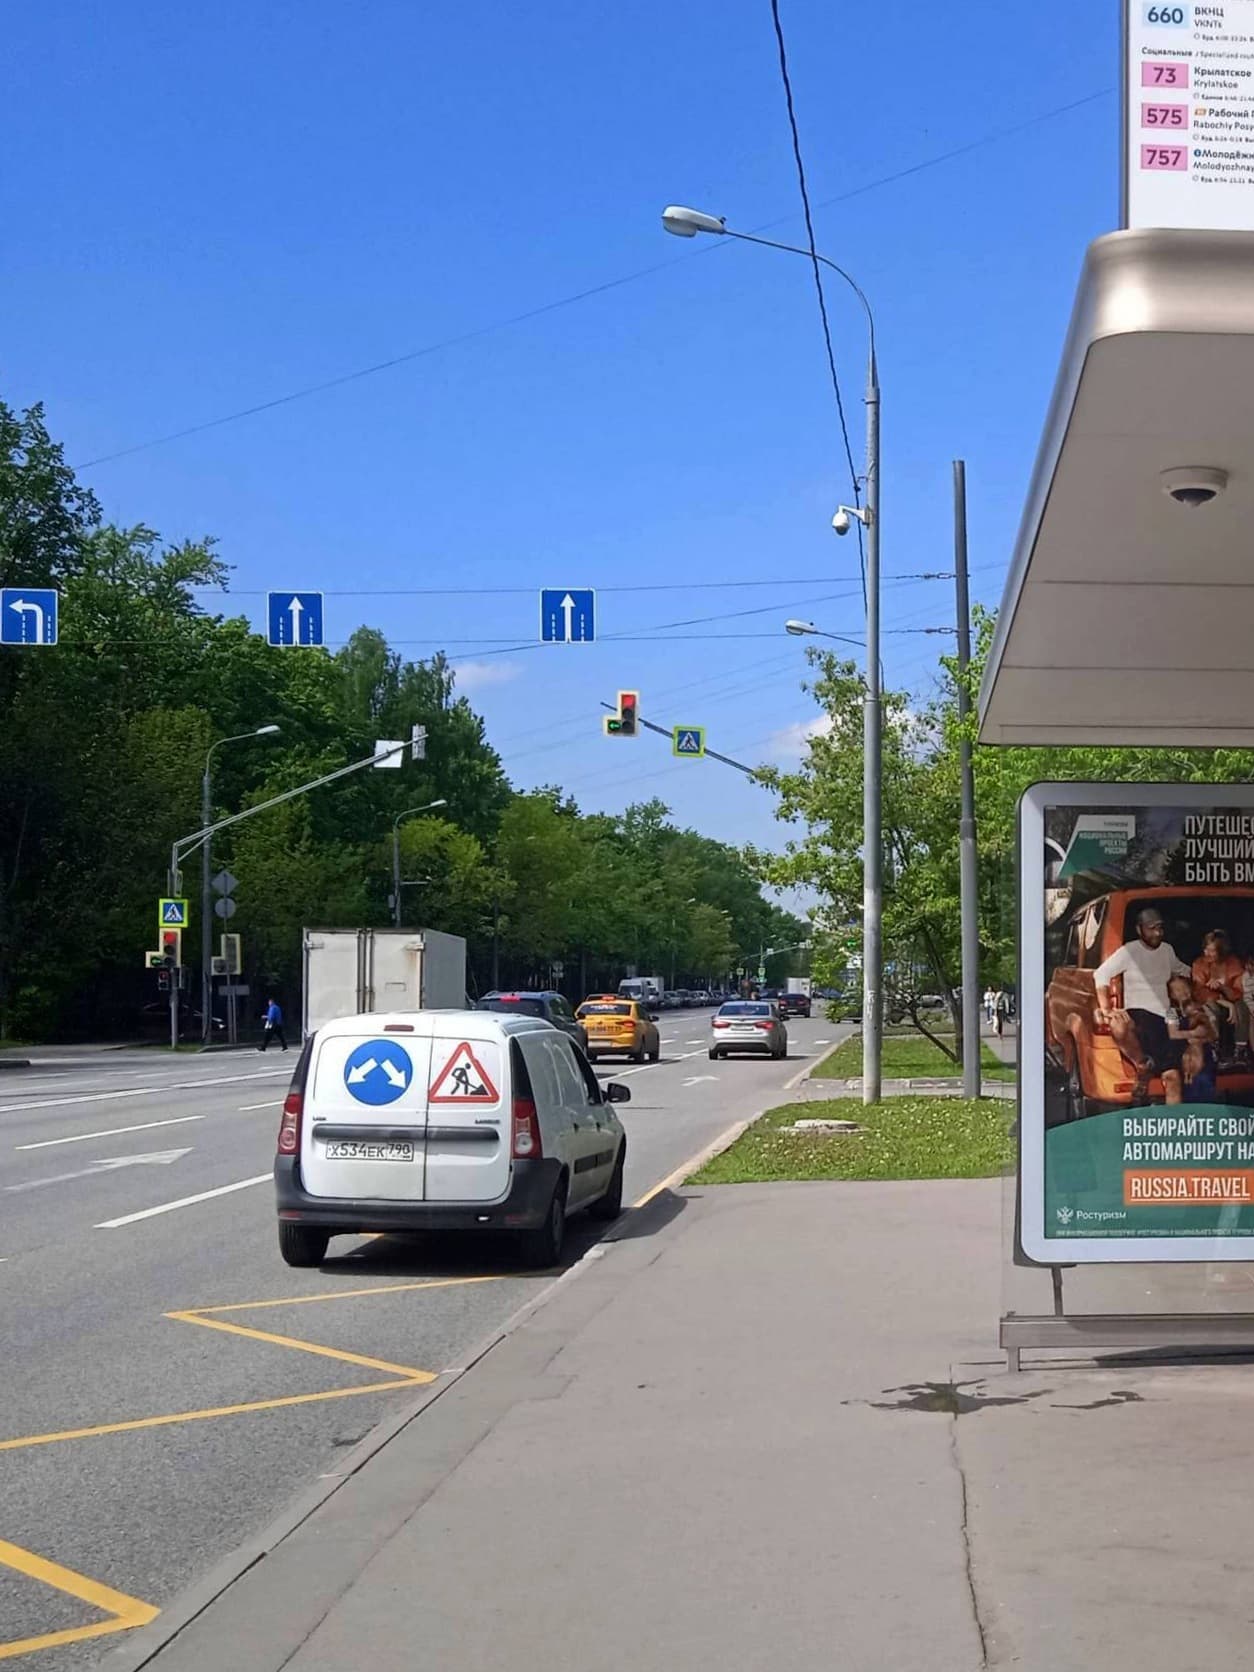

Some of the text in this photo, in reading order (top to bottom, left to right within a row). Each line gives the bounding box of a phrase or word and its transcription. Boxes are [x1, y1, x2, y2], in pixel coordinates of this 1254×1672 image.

[1147, 6, 1184, 24] 660
[1194, 6, 1224, 18] ВКНЦ
[1153, 67, 1176, 83] 73
[1194, 67, 1252, 78] Крылатское
[1193, 79, 1239, 89] Krylatskoe
[1147, 108, 1182, 125] 575
[1208, 108, 1249, 118] Рабочий
[1146, 149, 1182, 166] 757
[1185, 862, 1230, 882] БЫТЬ
[1123, 1114, 1214, 1137] ВЫБИРАЙТЕ
[331, 1142, 385, 1158] Х534ЕК
[1123, 1142, 1235, 1160] АВТОМАРШРУТ
[1131, 1177, 1251, 1199] RUSSIA.TRAVEL
[1076, 1210, 1127, 1221] Ростуризм
